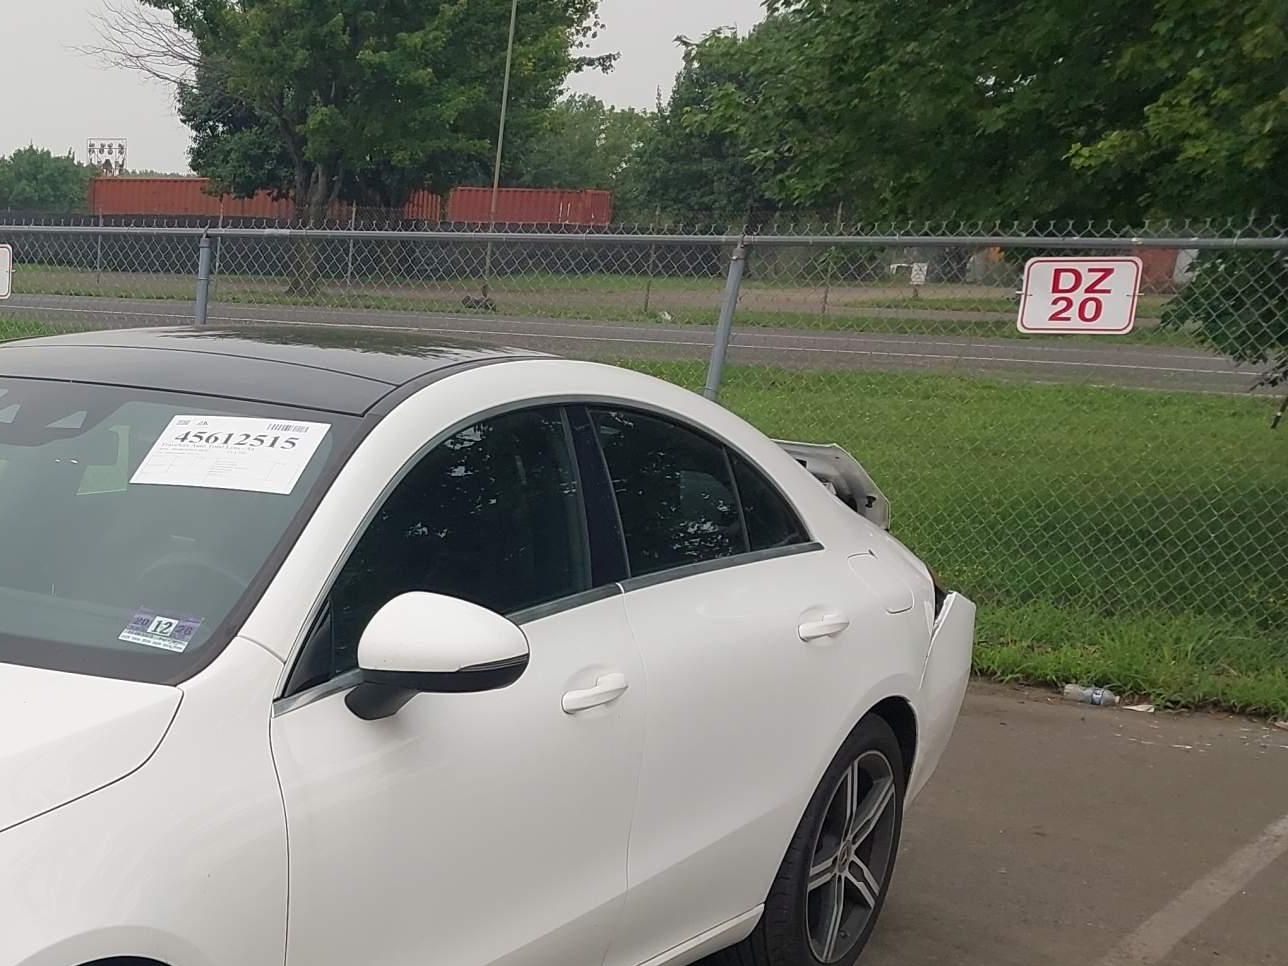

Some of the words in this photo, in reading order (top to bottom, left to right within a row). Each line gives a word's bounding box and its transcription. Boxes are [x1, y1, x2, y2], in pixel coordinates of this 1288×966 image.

[1051, 268, 1114, 294] DZ
[1047, 296, 1104, 323] 20
[174, 430, 300, 450] 45612515
[134, 616, 150, 627] 20
[152, 619, 174, 635] 12
